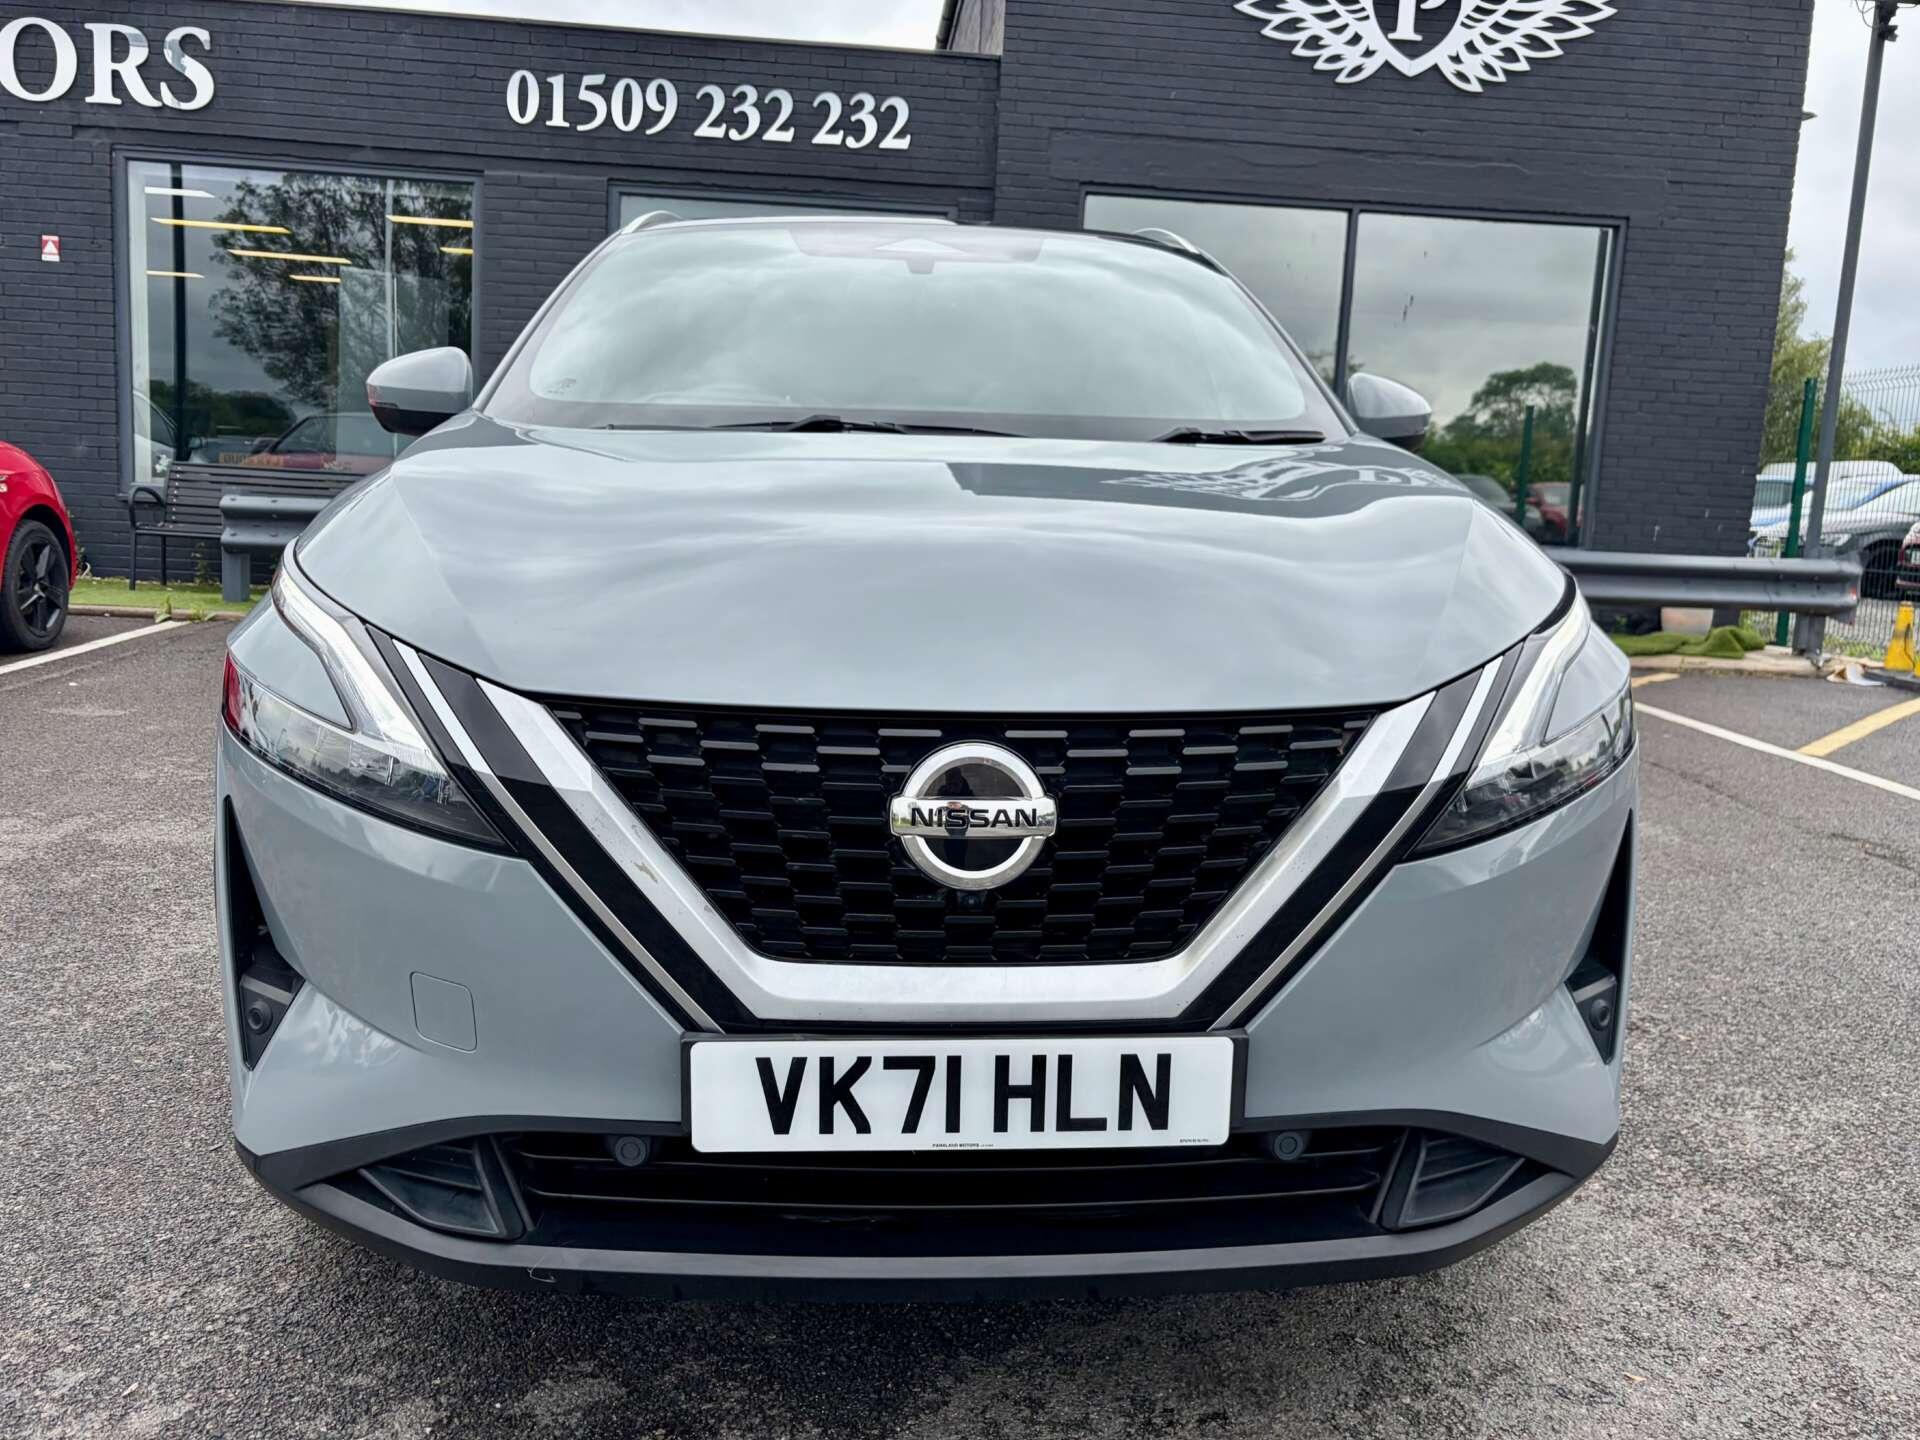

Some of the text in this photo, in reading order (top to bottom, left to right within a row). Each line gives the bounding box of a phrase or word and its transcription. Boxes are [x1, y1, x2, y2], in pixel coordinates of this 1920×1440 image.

[507, 70, 911, 149] 01509 232 232
[911, 808, 1037, 828] NISSAN
[756, 1054, 1171, 1135] VK71 HLN
